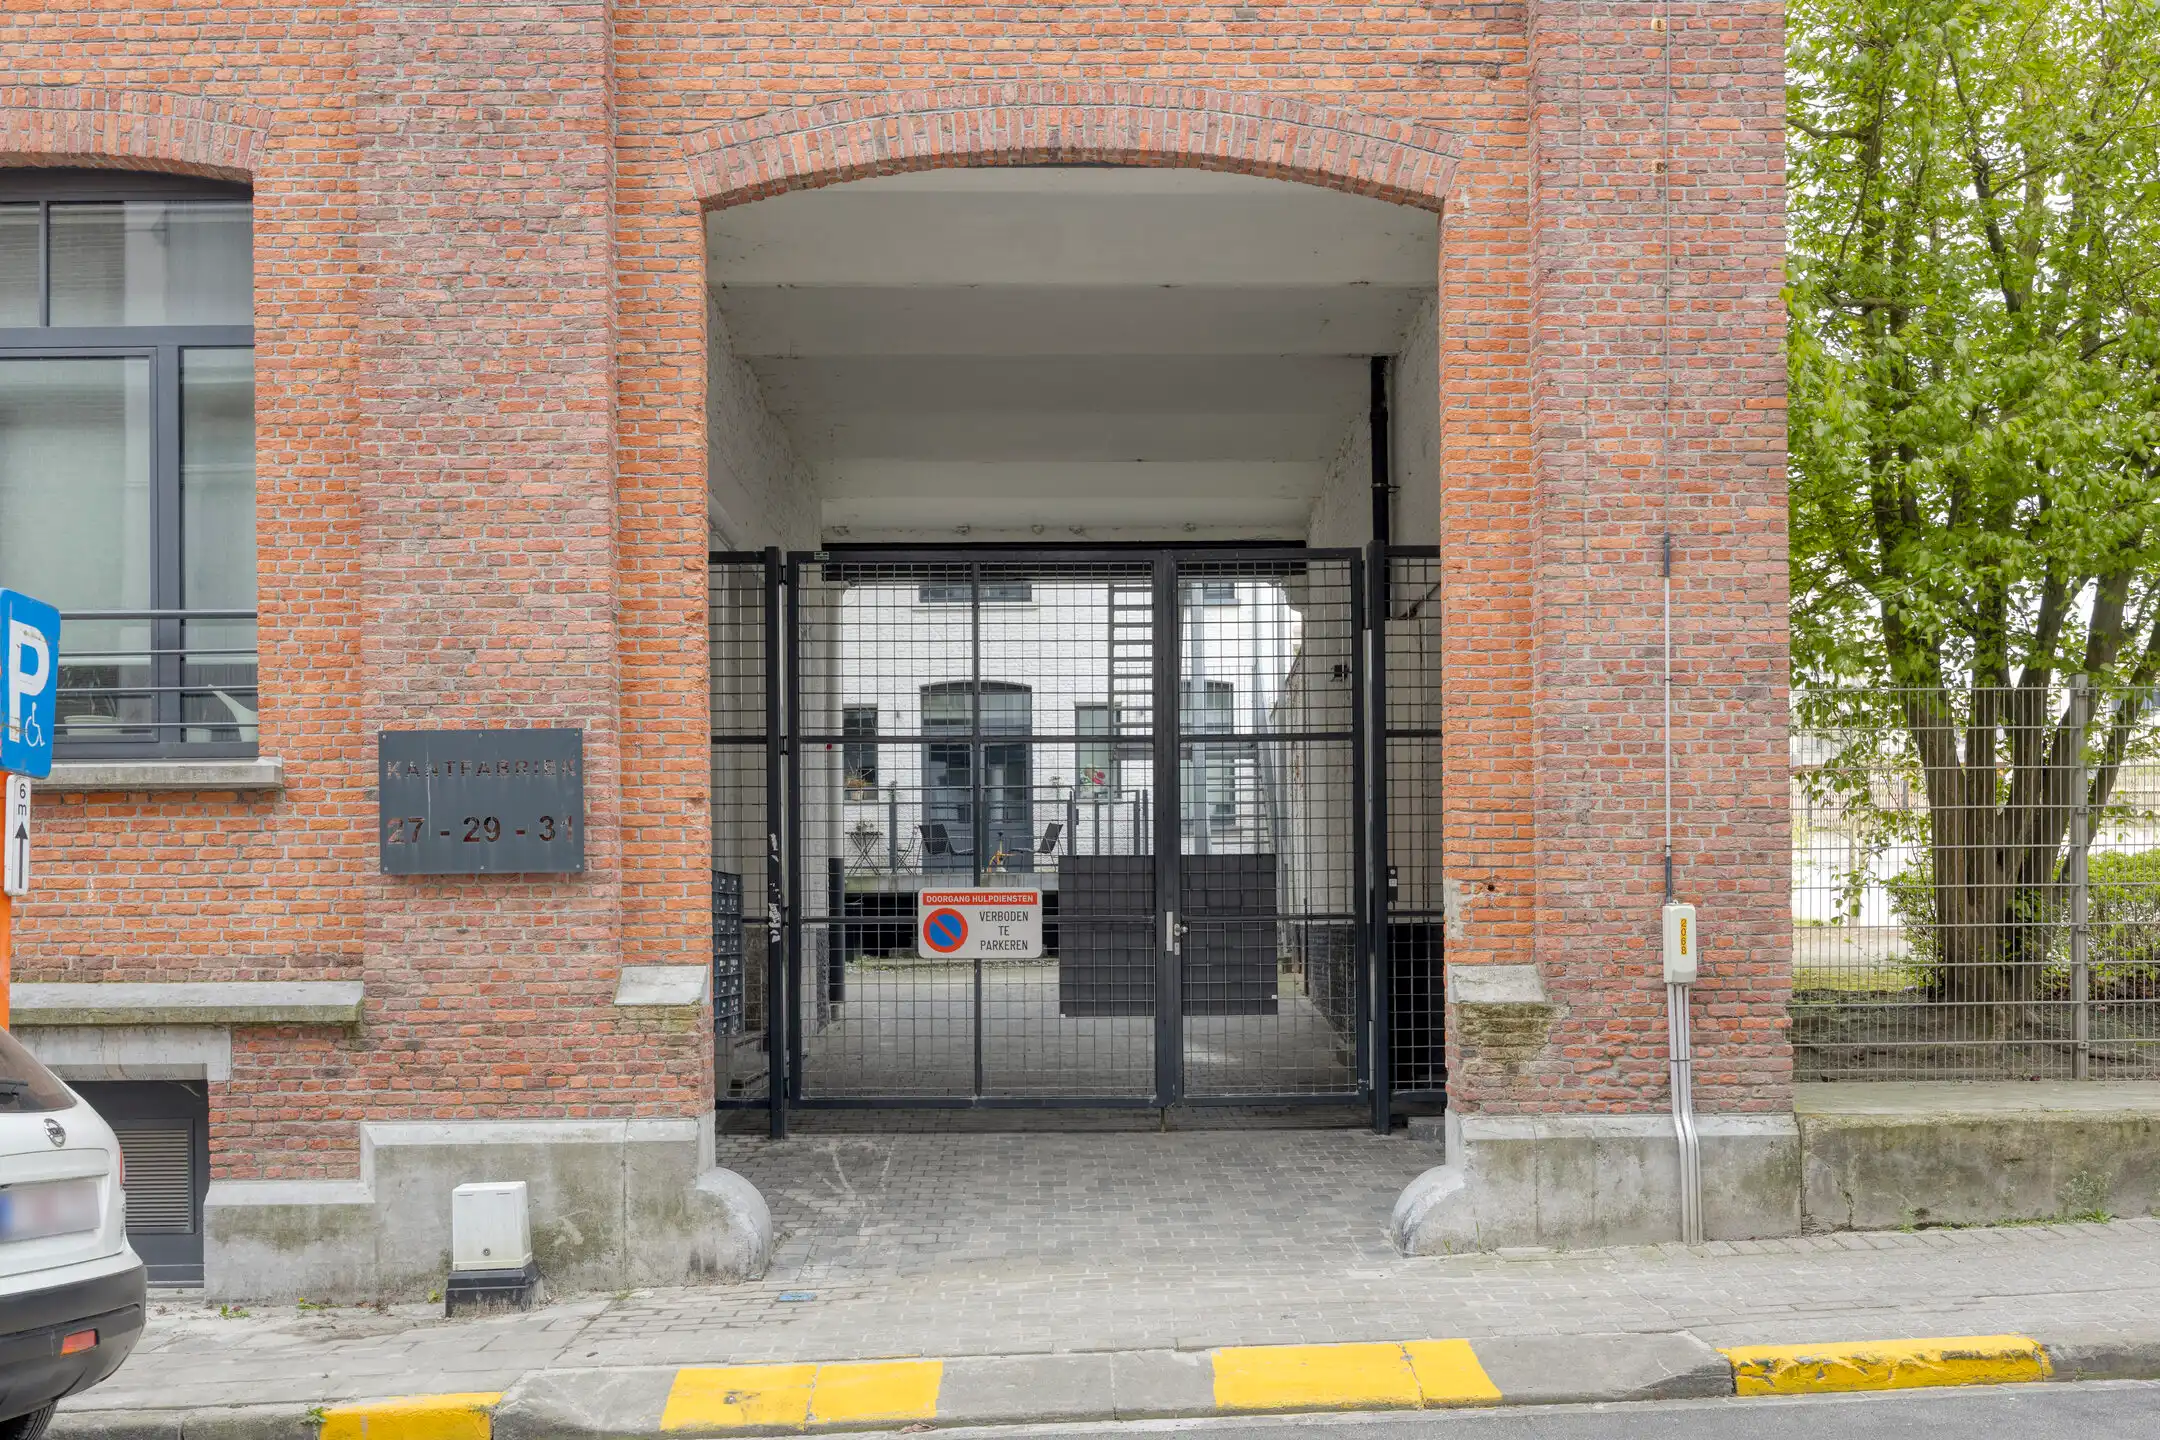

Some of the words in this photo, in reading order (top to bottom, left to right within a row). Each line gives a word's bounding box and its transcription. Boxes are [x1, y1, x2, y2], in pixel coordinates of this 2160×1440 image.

[9, 618, 50, 743] P
[386, 759, 576, 779] KANTFABRIEK
[19, 782, 27, 799] 6
[17, 803, 27, 816] m
[386, 816, 425, 845] 27
[462, 816, 501, 843] 29
[538, 815, 573, 842] 31
[926, 895, 970, 903] DOORGANG
[972, 894, 1034, 903] HULPDIENSTEN
[979, 911, 1029, 922] VERBODEN
[997, 925, 1010, 936] TE
[980, 939, 1028, 951] PARKEREN
